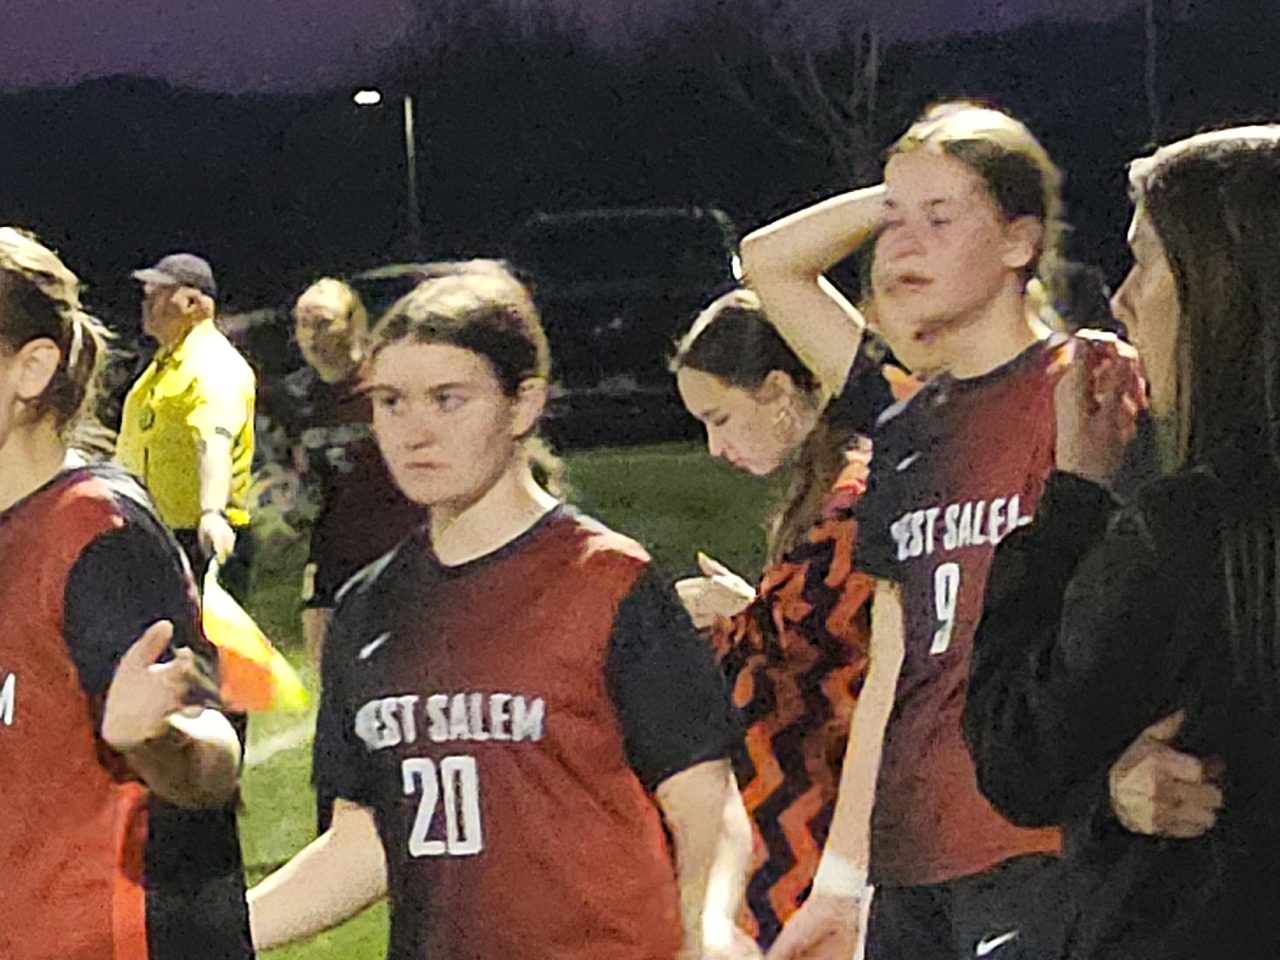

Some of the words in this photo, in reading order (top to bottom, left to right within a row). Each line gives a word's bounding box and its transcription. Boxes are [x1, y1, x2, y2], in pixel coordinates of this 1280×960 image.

[929, 562, 960, 656] 9
[426, 693, 545, 742] SALEM
[401, 755, 483, 857] 20
